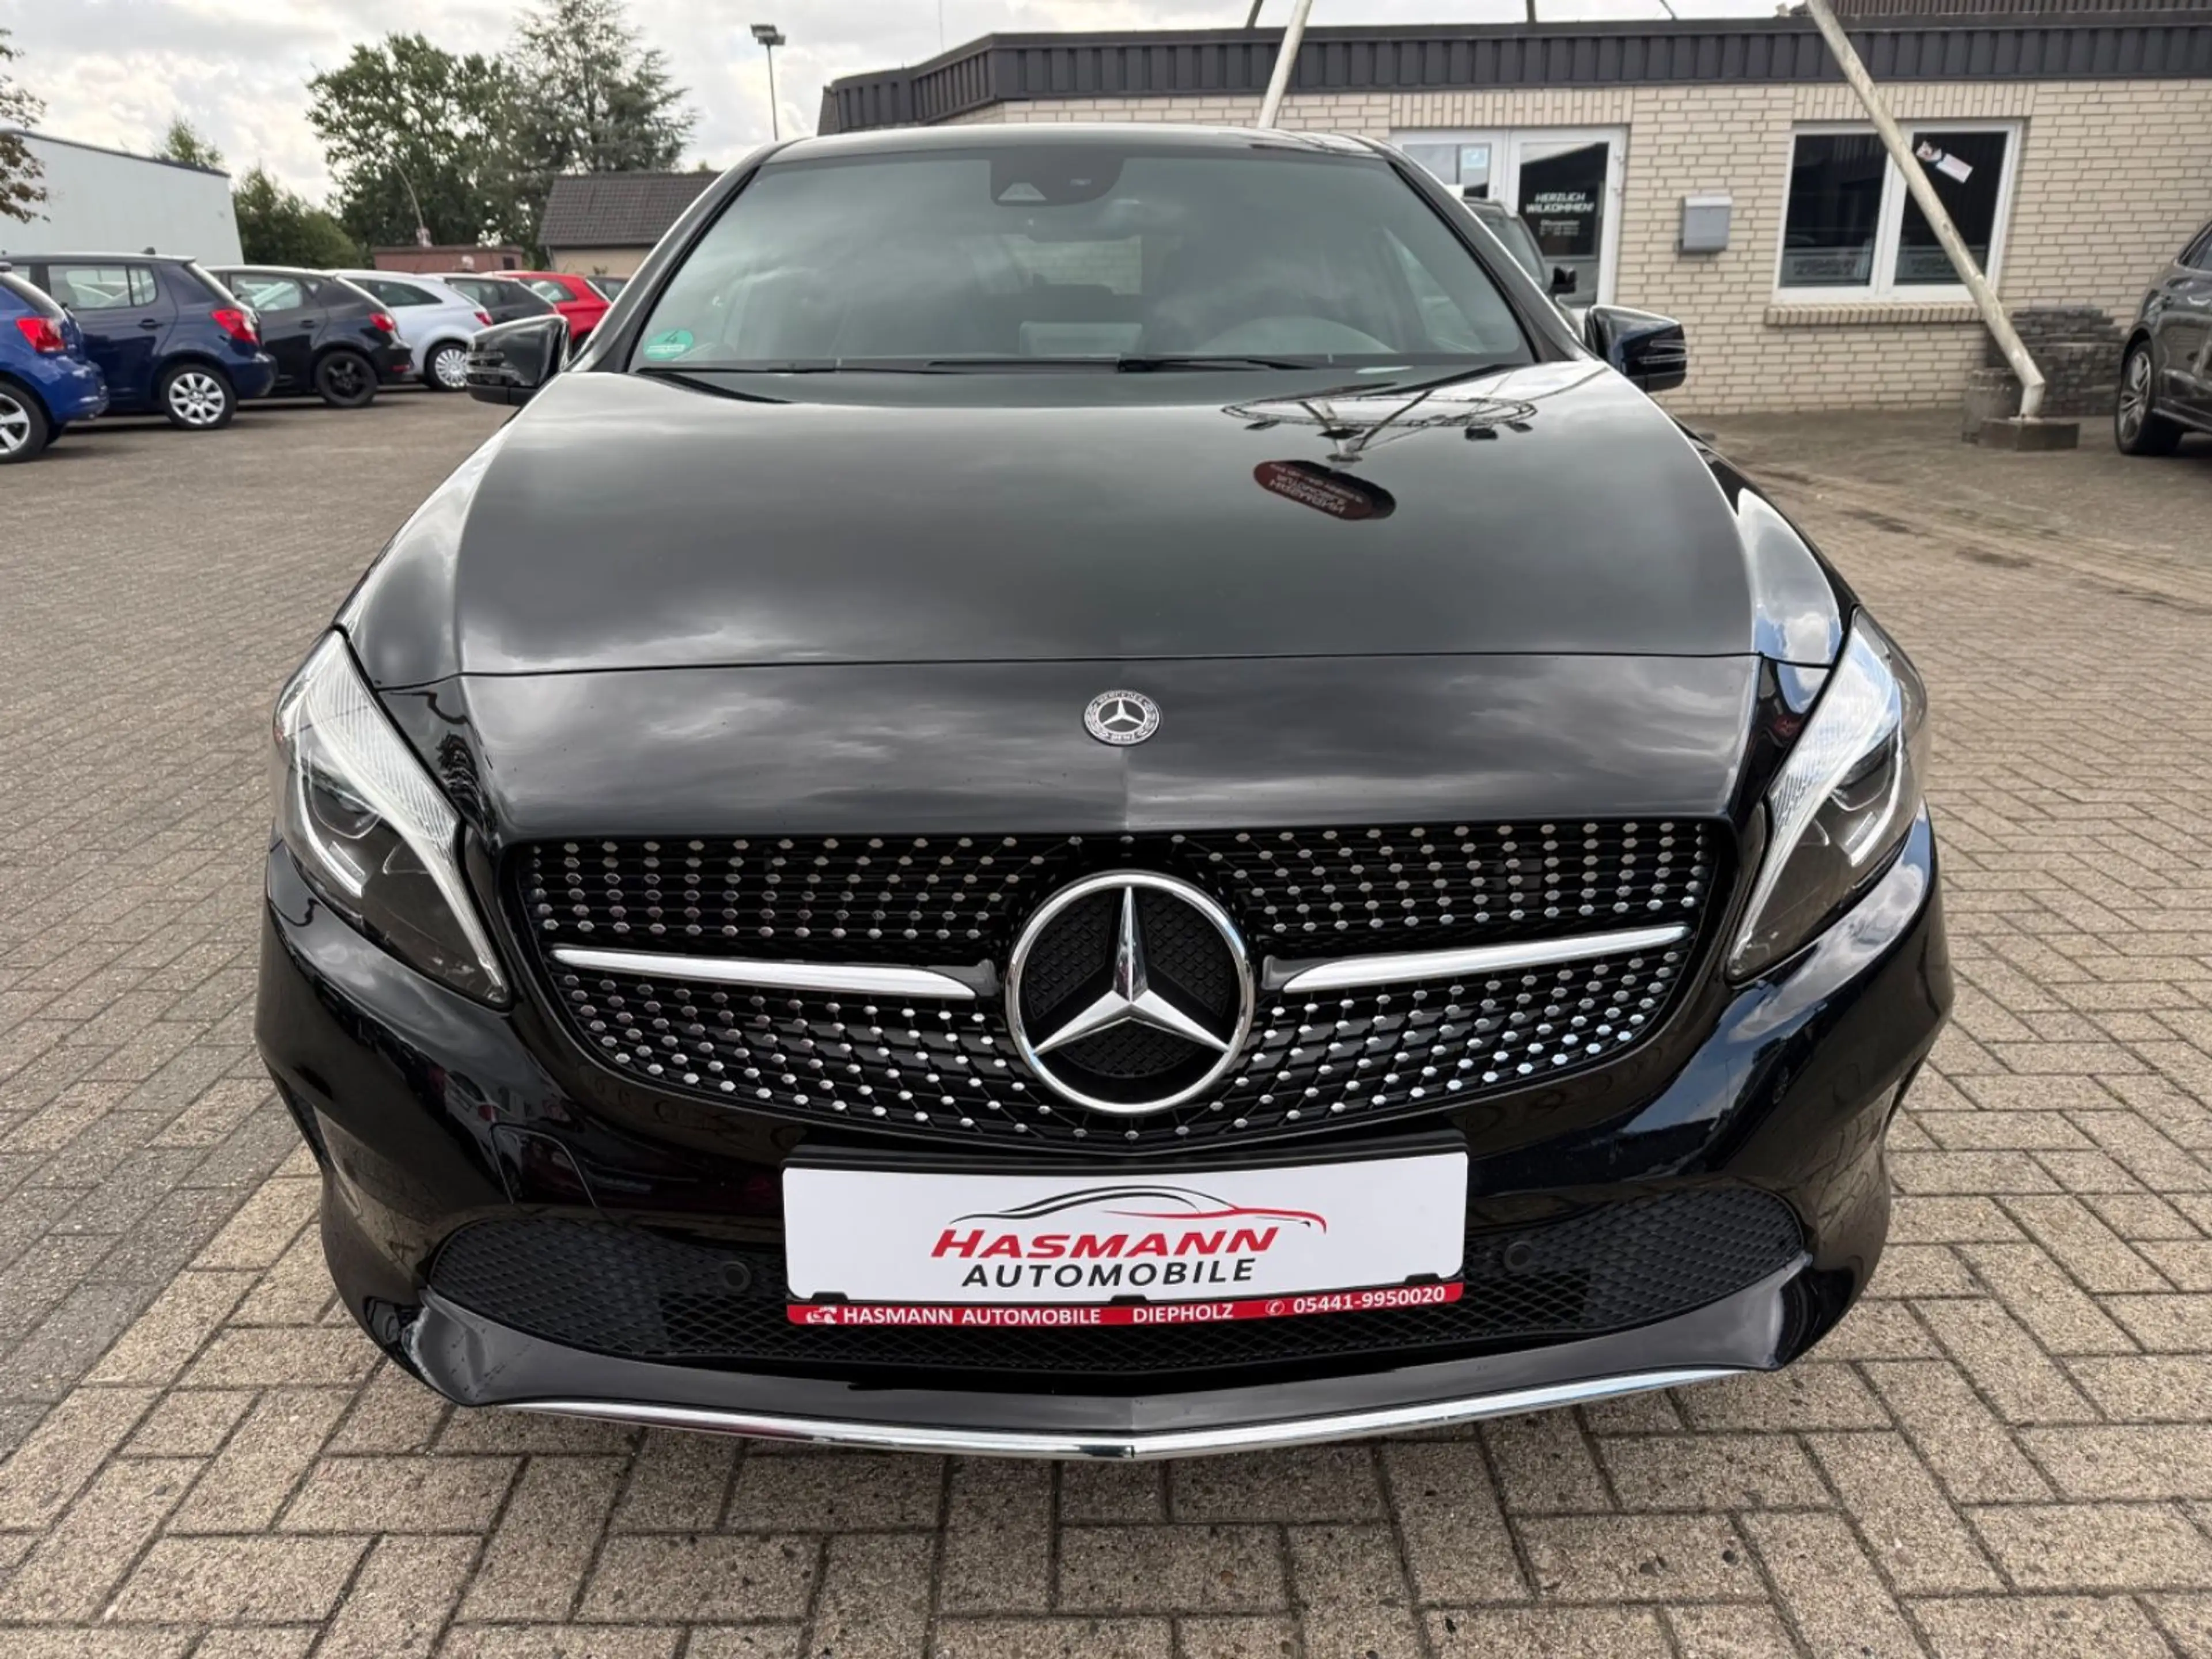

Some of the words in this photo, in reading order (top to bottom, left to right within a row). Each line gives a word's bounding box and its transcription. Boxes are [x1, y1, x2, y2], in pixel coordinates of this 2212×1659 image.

[931, 1226, 1279, 1259] HASMANN
[961, 1257, 1256, 1287] AUTOMOBILE
[843, 1307, 954, 1324] HASMANN
[961, 1308, 1101, 1325] AUTOMOBILE
[1132, 1304, 1233, 1323] DIEPHOLZ
[1293, 1285, 1445, 1313] 05441-9950020
